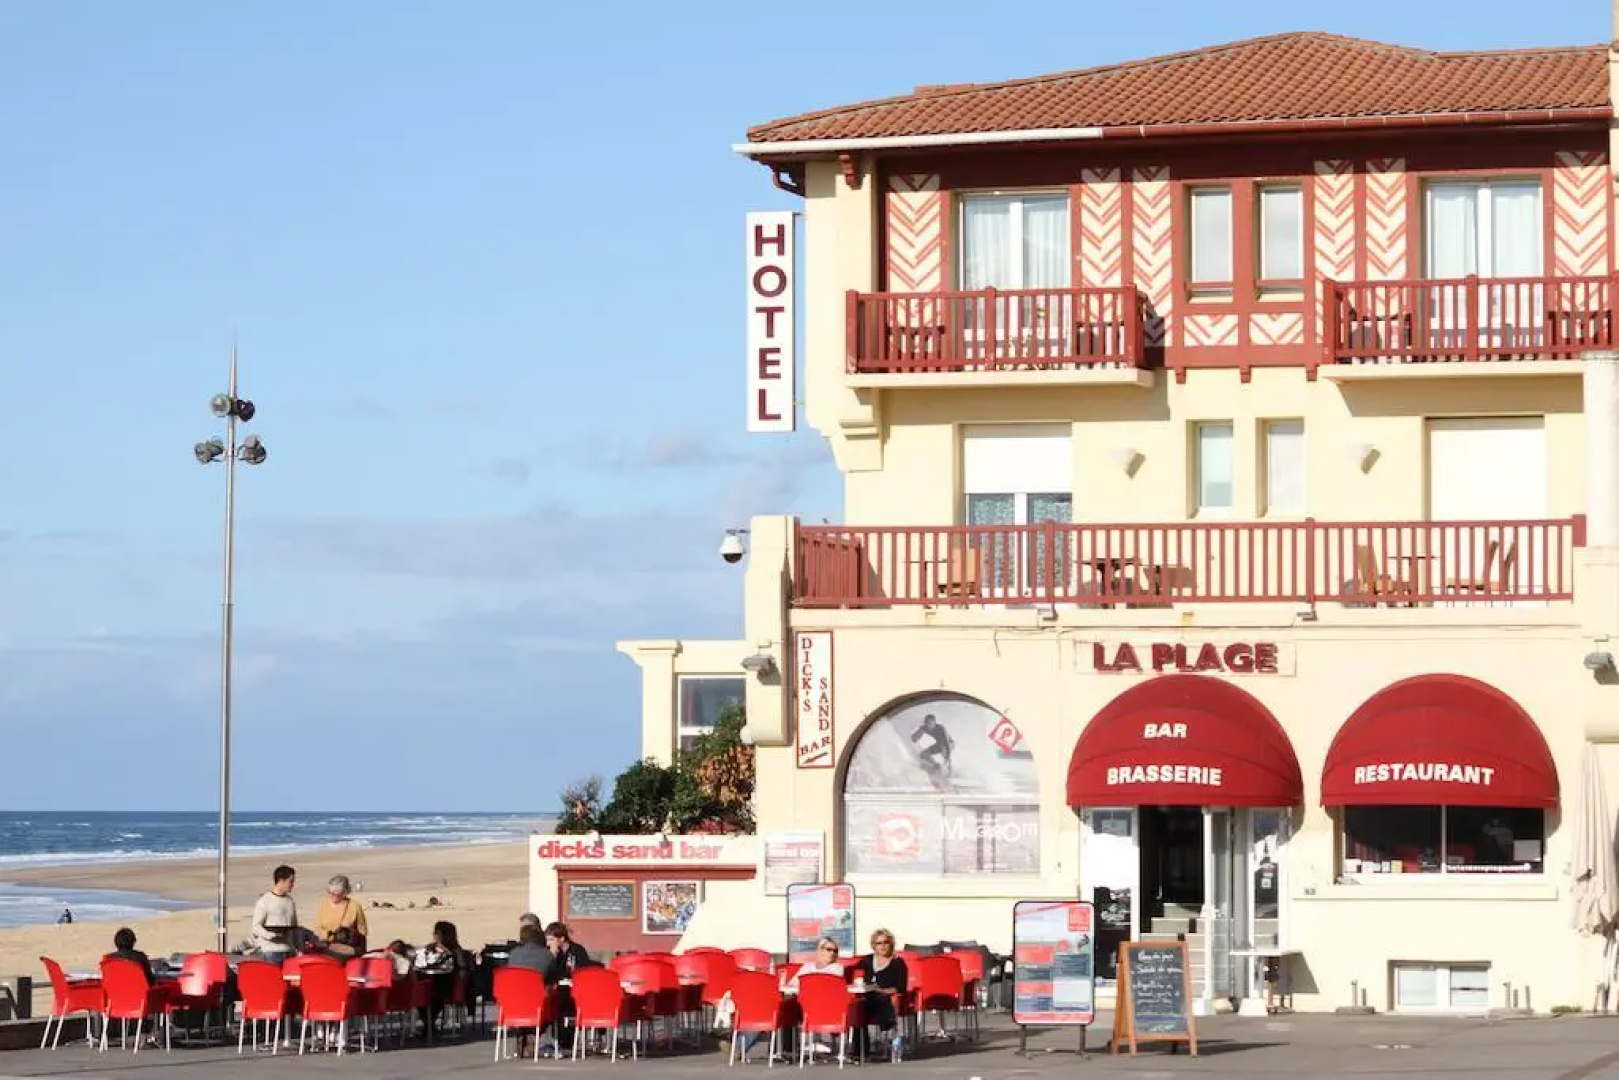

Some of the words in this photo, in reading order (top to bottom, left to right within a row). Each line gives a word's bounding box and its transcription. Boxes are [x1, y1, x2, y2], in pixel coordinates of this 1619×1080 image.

[752, 223, 787, 421] HOTEL
[1093, 641, 1143, 672] LA
[1151, 642, 1278, 674] PLAGE
[801, 637, 813, 713] DICK'S
[818, 676, 830, 732] SAND
[1143, 722, 1188, 739] BAR
[800, 736, 831, 756] BAR
[1106, 764, 1222, 786] BRASSERIE
[1354, 762, 1495, 785] RESTAURANT
[538, 840, 605, 859] dicks
[612, 840, 674, 859] sand
[680, 840, 724, 859] bar
